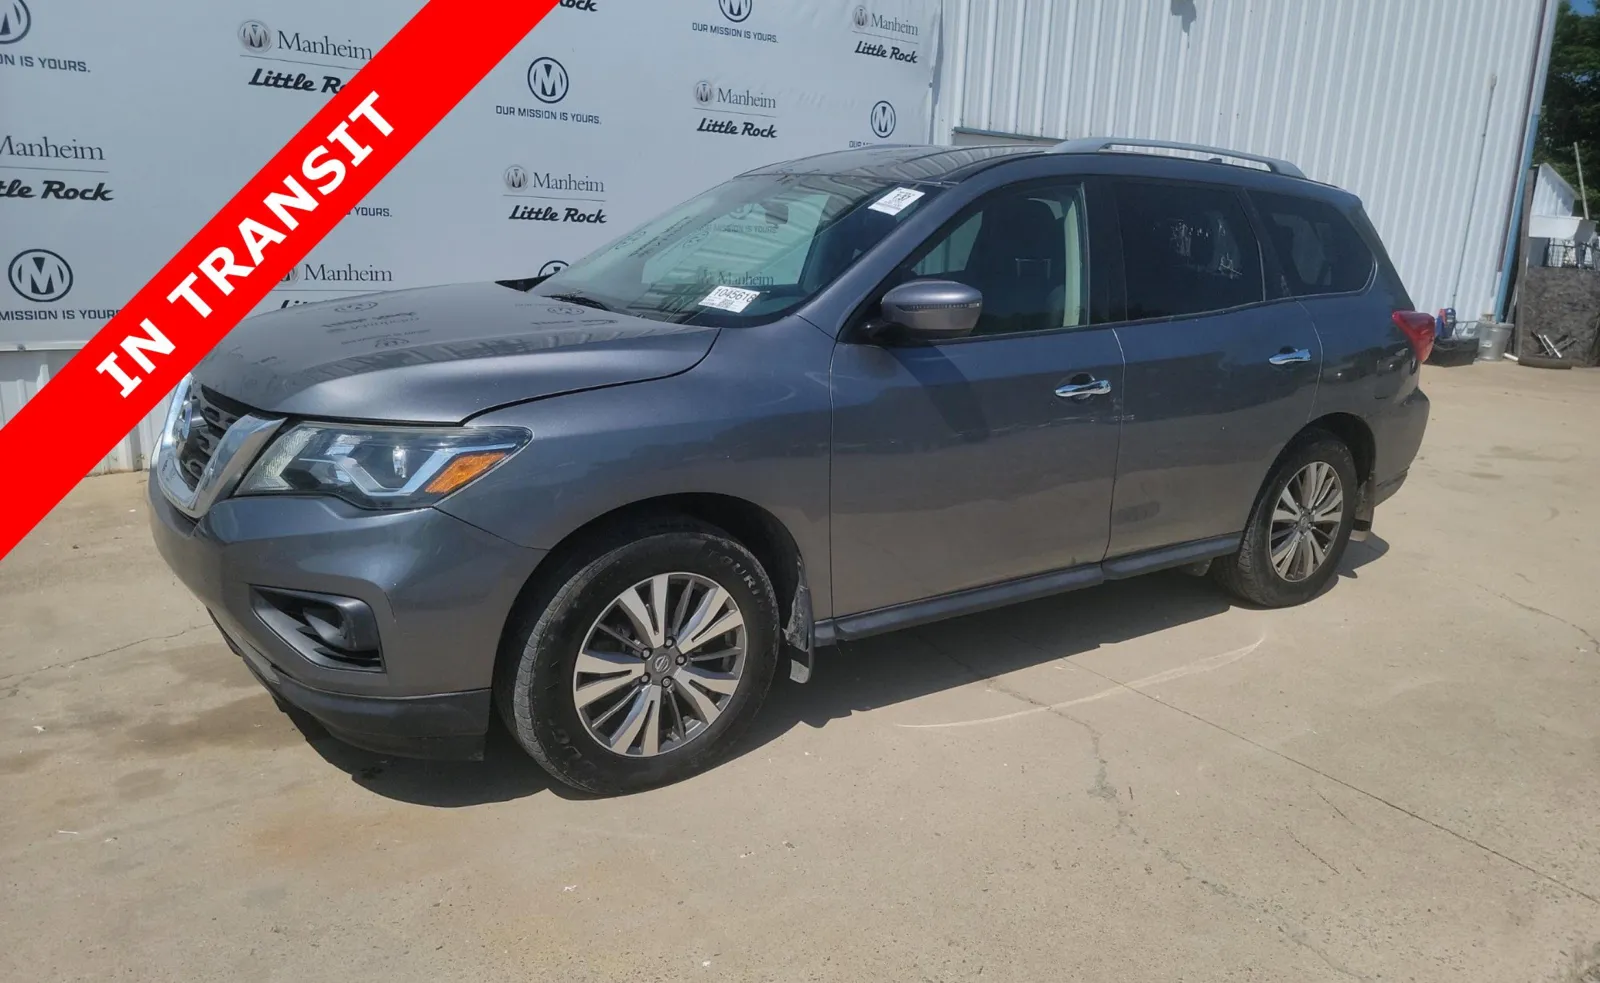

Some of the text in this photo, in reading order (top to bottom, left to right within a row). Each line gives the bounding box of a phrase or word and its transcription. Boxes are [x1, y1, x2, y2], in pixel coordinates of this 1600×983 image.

[692, 22, 779, 43] OUR MISSION IS YOURS.
[870, 13, 918, 36] Manheim
[277, 29, 373, 60] Manheim
[854, 40, 918, 63] Little Rock
[20, 55, 34, 67] IS
[38, 57, 91, 73] YOURS.
[248, 68, 317, 92] Little
[716, 87, 776, 108] Manheim
[495, 105, 602, 125] OUR MISSION IS YOURS.
[696, 117, 778, 138] Little Rock
[41, 180, 114, 202] Rock
[533, 172, 605, 192] Manheim
[354, 206, 393, 217] YOURS.
[508, 205, 607, 223] Little Rock
[304, 263, 394, 282] Manheim
[62, 309, 76, 320] IS
[79, 309, 121, 320] YOUR
